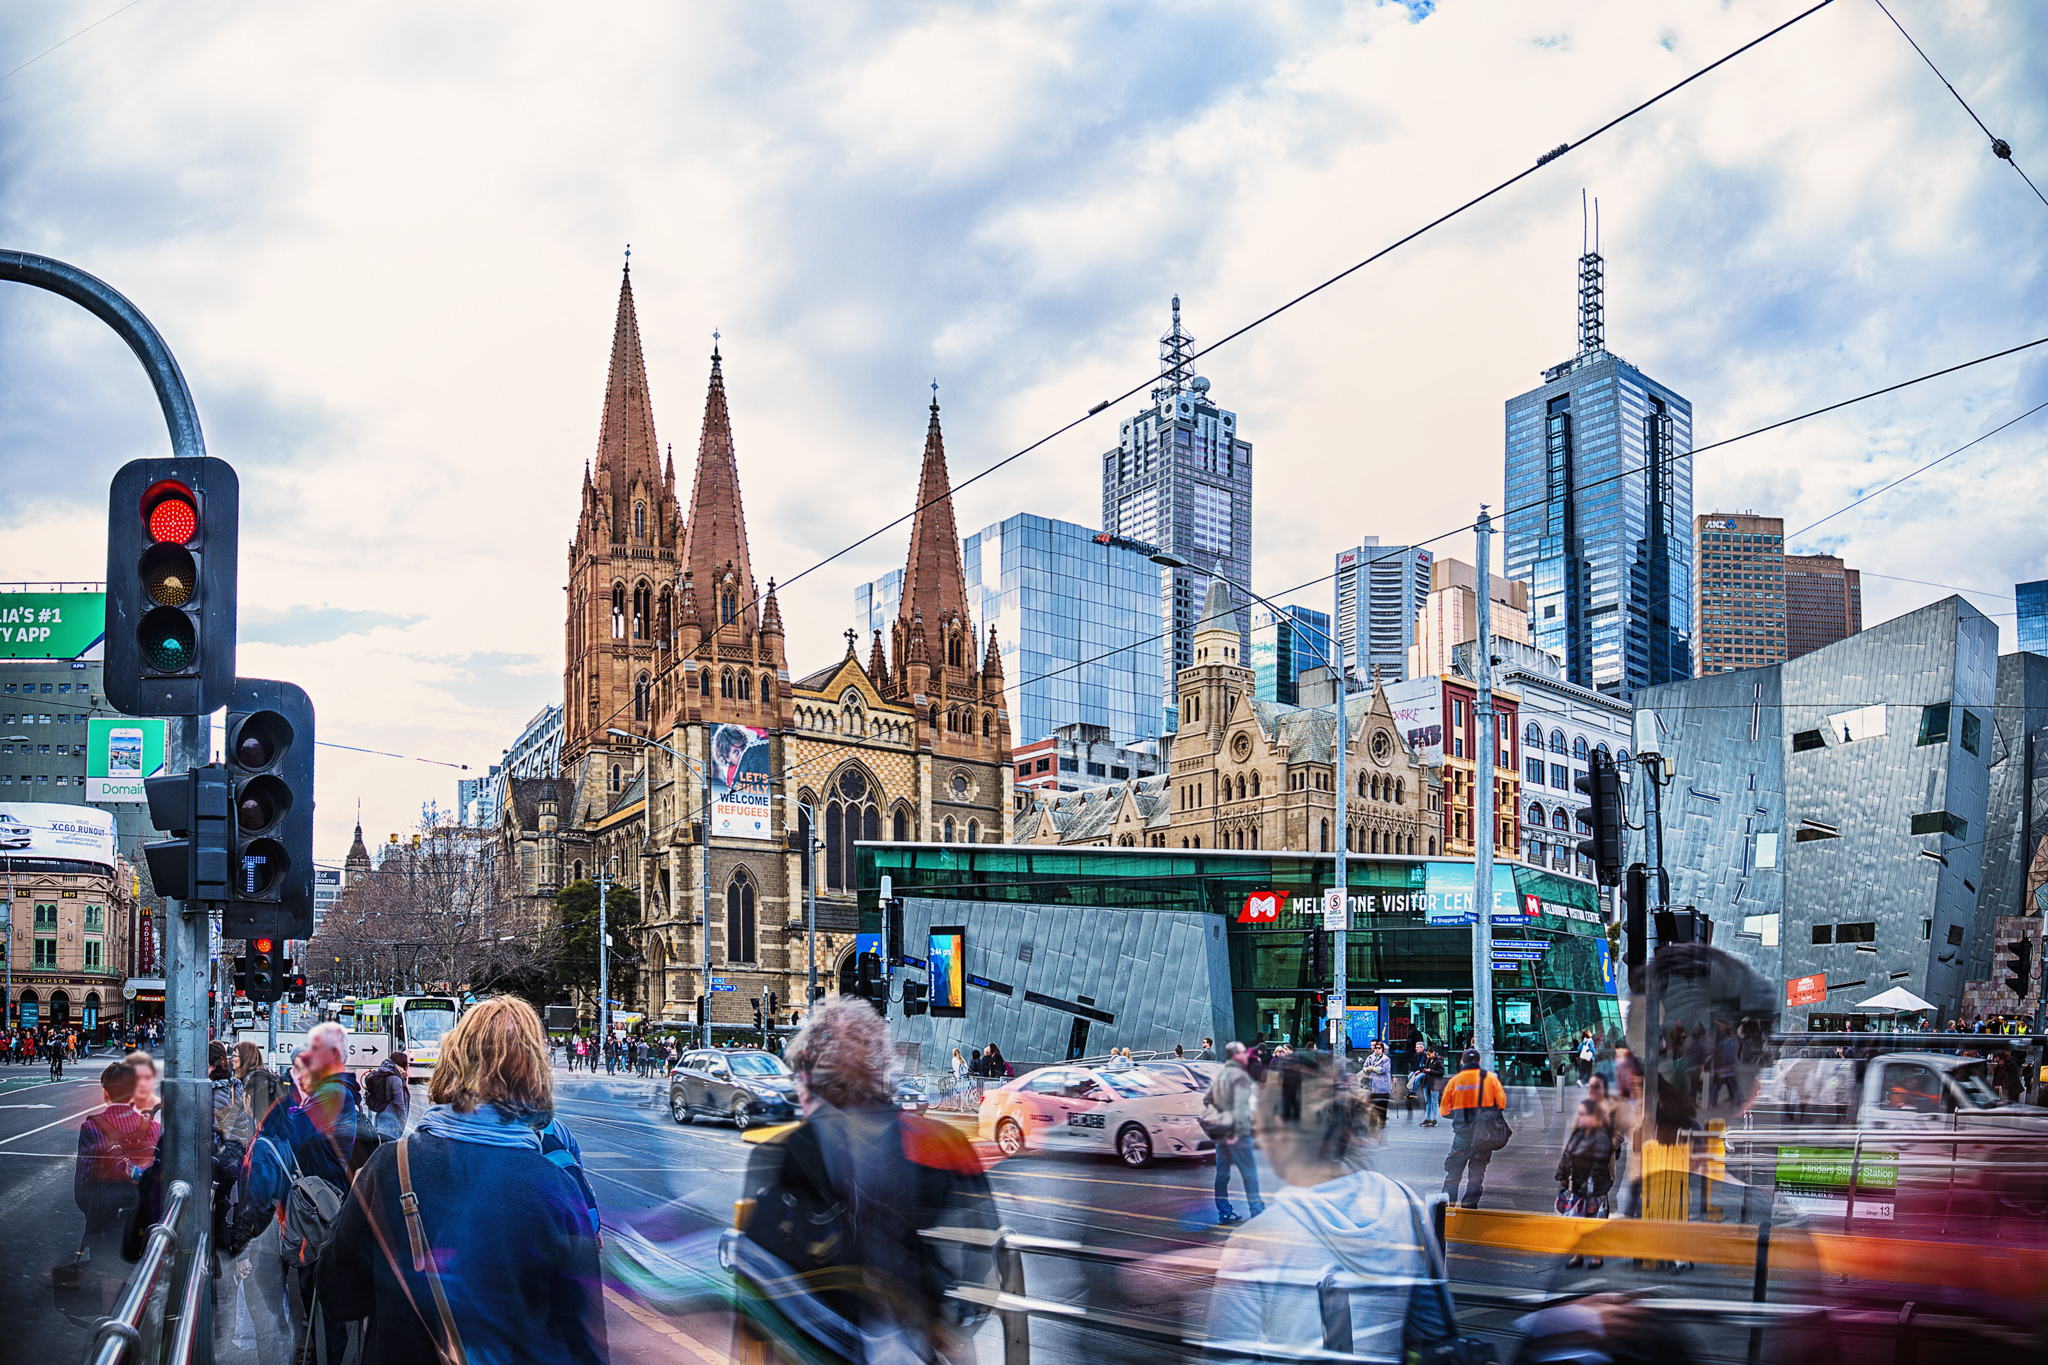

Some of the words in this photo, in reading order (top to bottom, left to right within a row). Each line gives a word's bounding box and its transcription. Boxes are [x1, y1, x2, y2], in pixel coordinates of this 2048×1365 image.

[1704, 520, 1726, 529] ANZ
[1787, 558, 1841, 567] SOFITEL
[0, 607, 34, 623] IA'S
[38, 608, 62, 623] #1
[16, 627, 51, 642] APP
[740, 771, 769, 784] LET'S
[736, 783, 769, 795] FULLY
[720, 793, 769, 806] WELCOME
[718, 804, 769, 818] REFUGEES
[52, 823, 76, 832] XC60
[1293, 896, 1375, 914] MELRNE
[1382, 894, 1437, 912] VISITOR
[1444, 892, 1502, 910] CENE
[1542, 901, 1569, 918] MELBOURNE
[1568, 907, 1586, 921] VISITOR
[1584, 911, 1601, 924] CENTRE
[930, 948, 942, 956] 3:44
[942, 949, 950, 957] pm
[0, 977, 23, 985] ONG
[1802, 1164, 1834, 1174] Flinders
[1836, 1166, 1861, 1176] Stre
[1863, 1168, 1894, 1178] Station
[1880, 1206, 1890, 1216] 13
